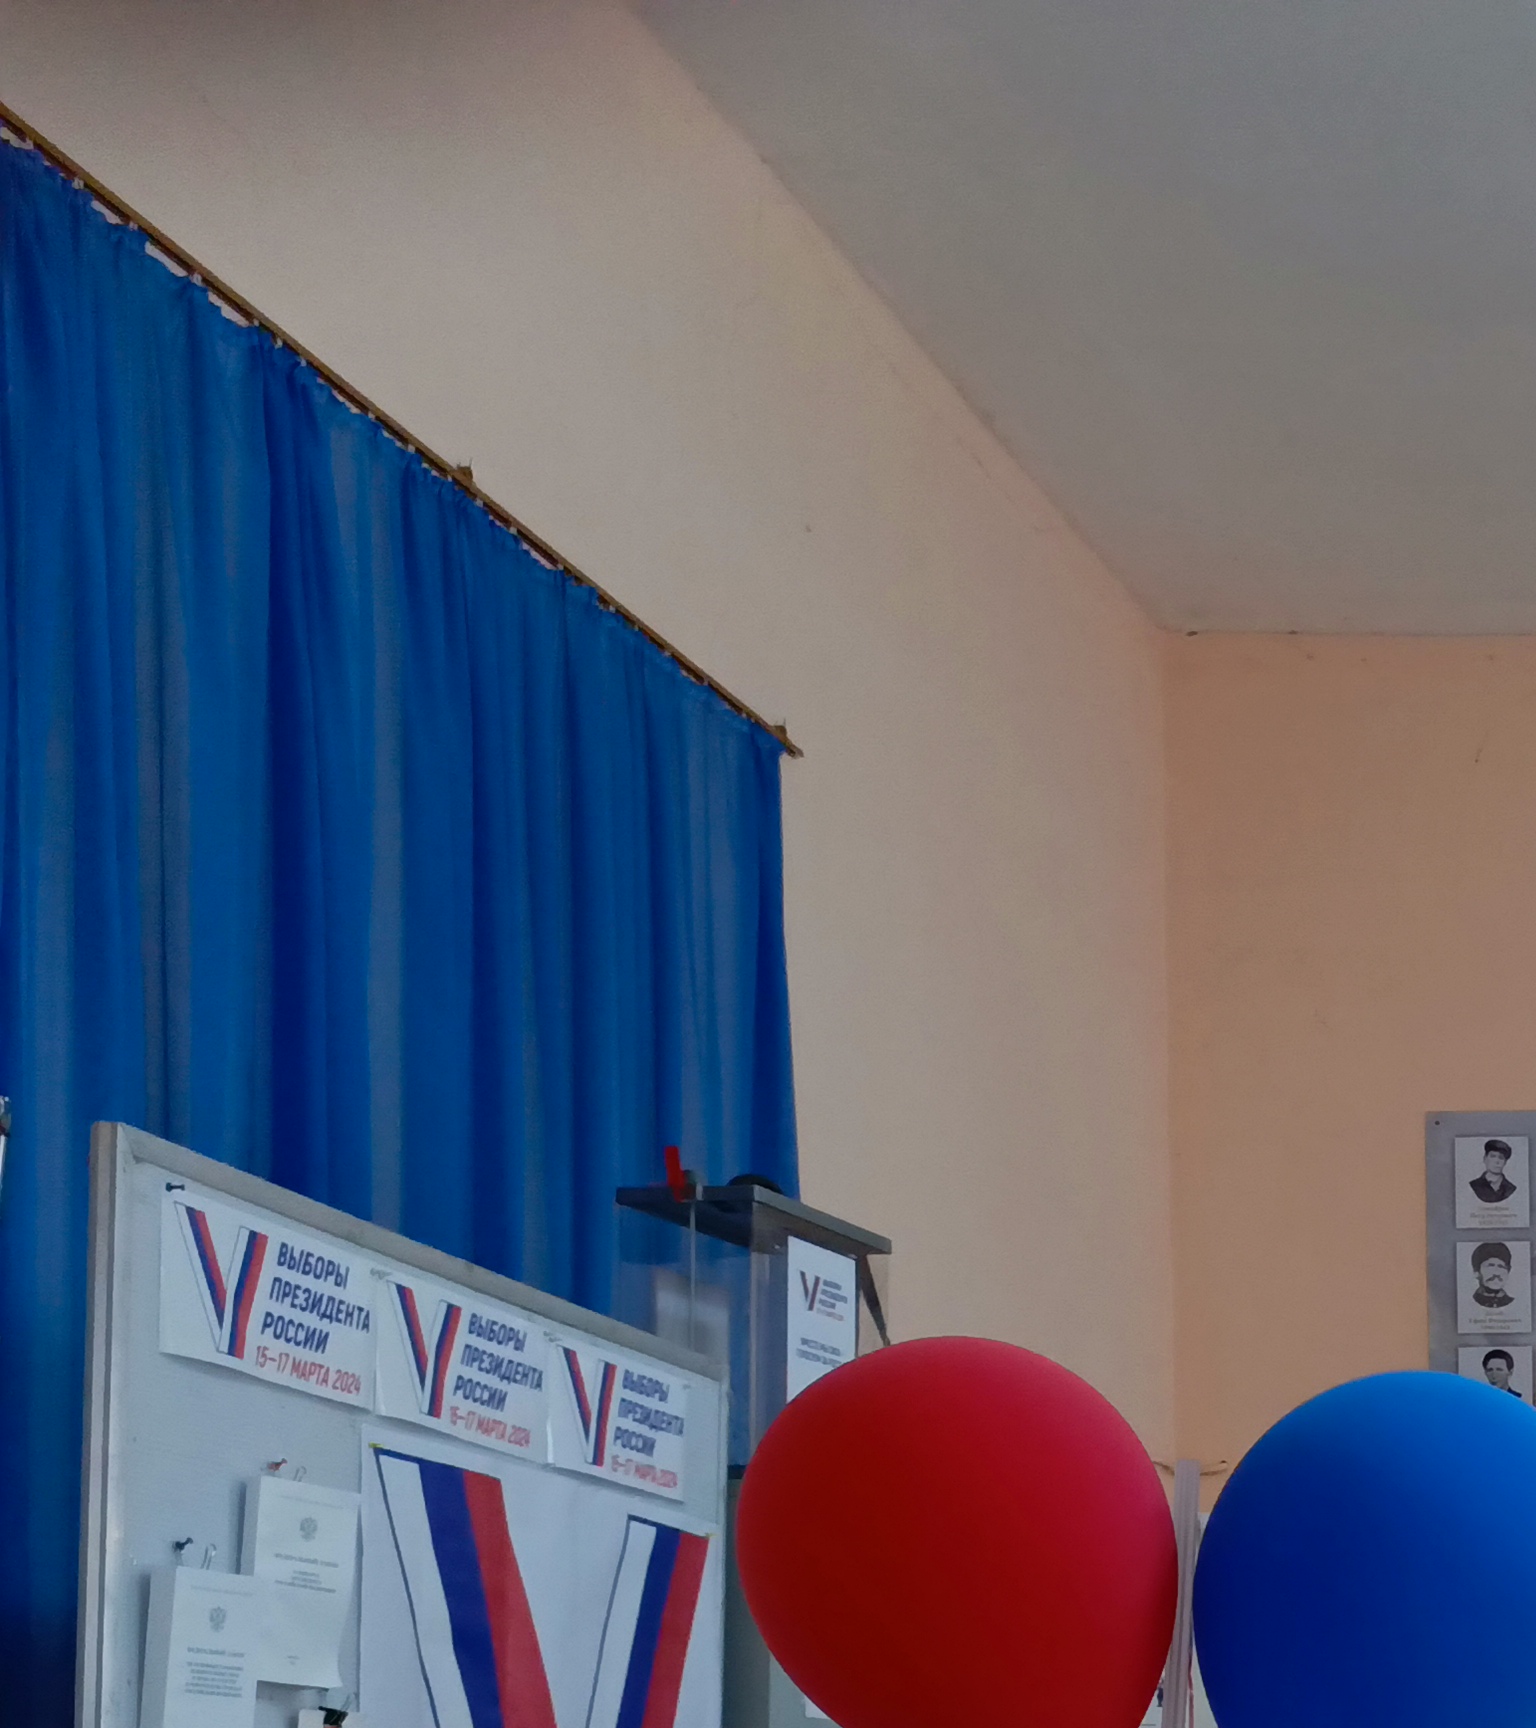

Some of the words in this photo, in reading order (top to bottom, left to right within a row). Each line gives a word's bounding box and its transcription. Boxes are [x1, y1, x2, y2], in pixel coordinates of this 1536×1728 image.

[277, 1241, 350, 1289] ВЫБОРЫ
[269, 1277, 371, 1334] ПРЕЗИДЕНТА
[261, 1311, 330, 1354] РОССИИ
[468, 1313, 527, 1352] ВЫБОРЫ
[290, 1356, 329, 1387] МАРТА
[332, 1369, 362, 1395] 2024
[460, 1344, 544, 1392] ПРЕЗИДЕНТА
[453, 1375, 508, 1412] РОССИИ
